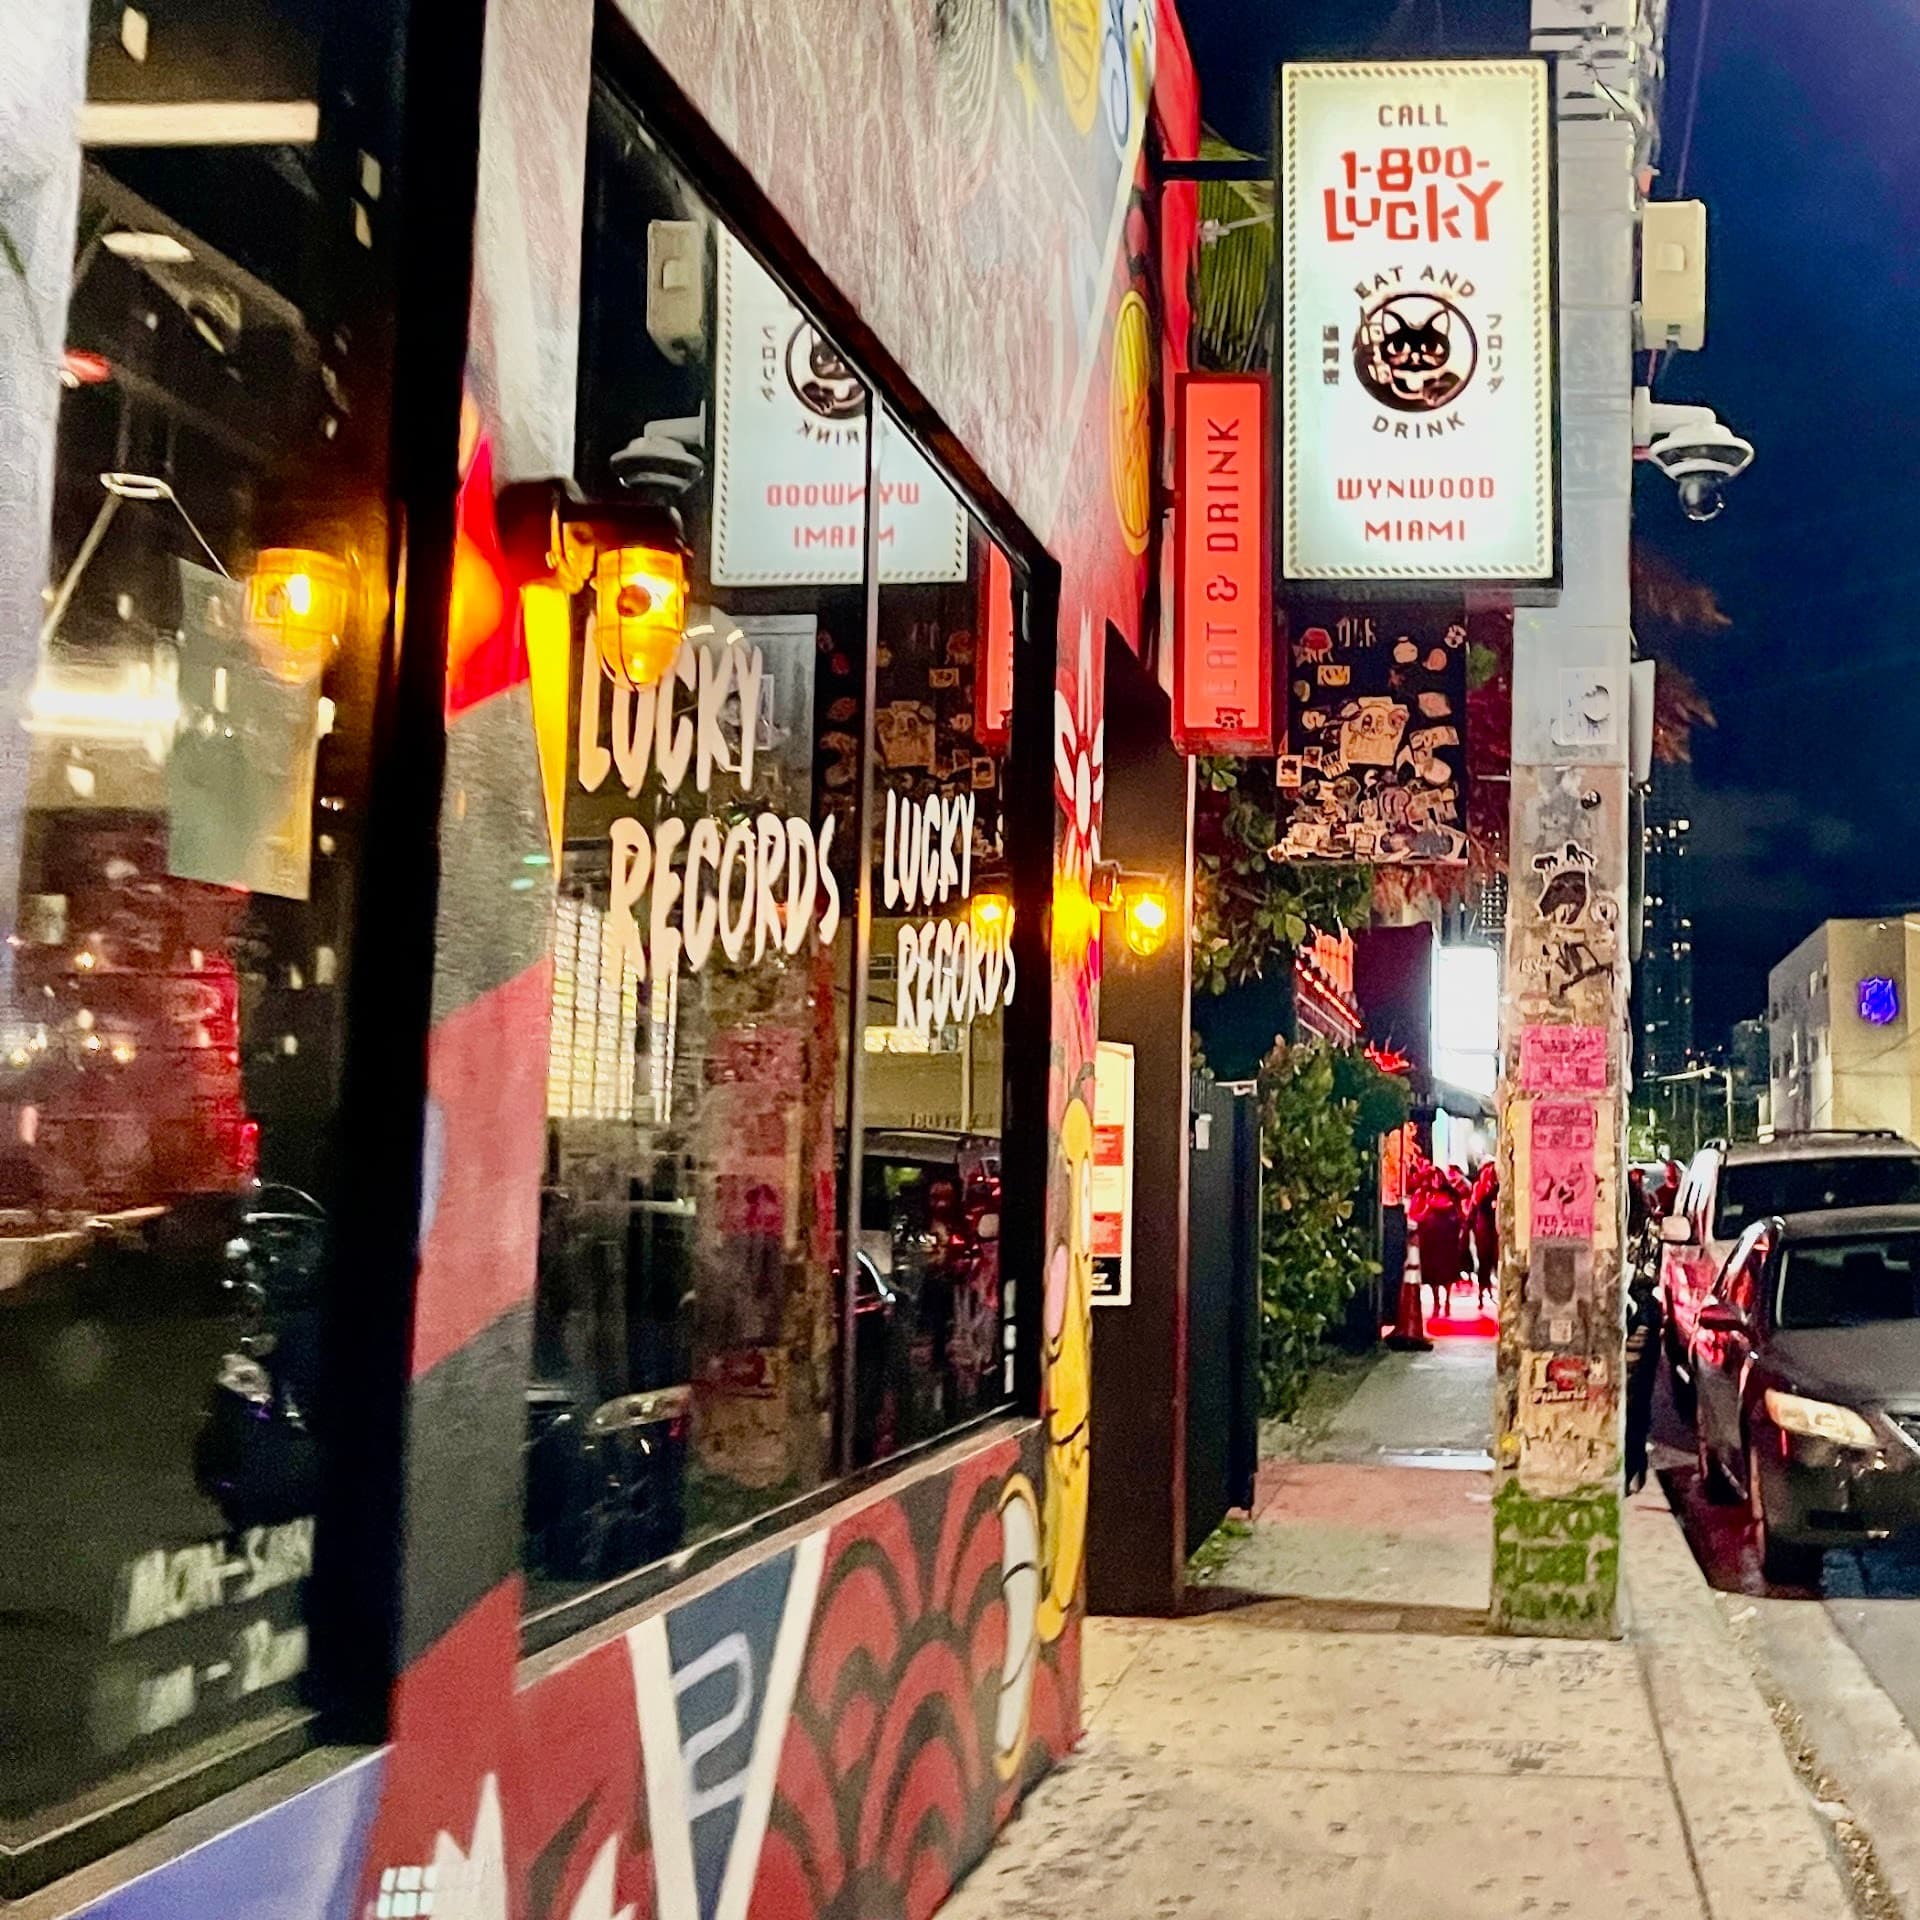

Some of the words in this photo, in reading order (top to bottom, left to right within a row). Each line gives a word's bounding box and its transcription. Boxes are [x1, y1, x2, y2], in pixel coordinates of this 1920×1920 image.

[1378, 103, 1448, 127] CALL
[1341, 146, 1490, 193] 1-800-
[1353, 265, 1404, 300] EAT
[1419, 265, 1476, 298] AND
[1372, 411, 1467, 439] DRINK
[1207, 418, 1240, 552] DRINK
[1336, 477, 1496, 500] WYNWOOD
[1364, 519, 1466, 543] MIAMI
[1206, 574, 1239, 602] &
[1206, 621, 1239, 697] EAT
[578, 611, 763, 799] LUCKY
[883, 788, 976, 912] LUCKY
[610, 812, 840, 984] RECORDS
[896, 904, 1016, 1040] RECORDS
